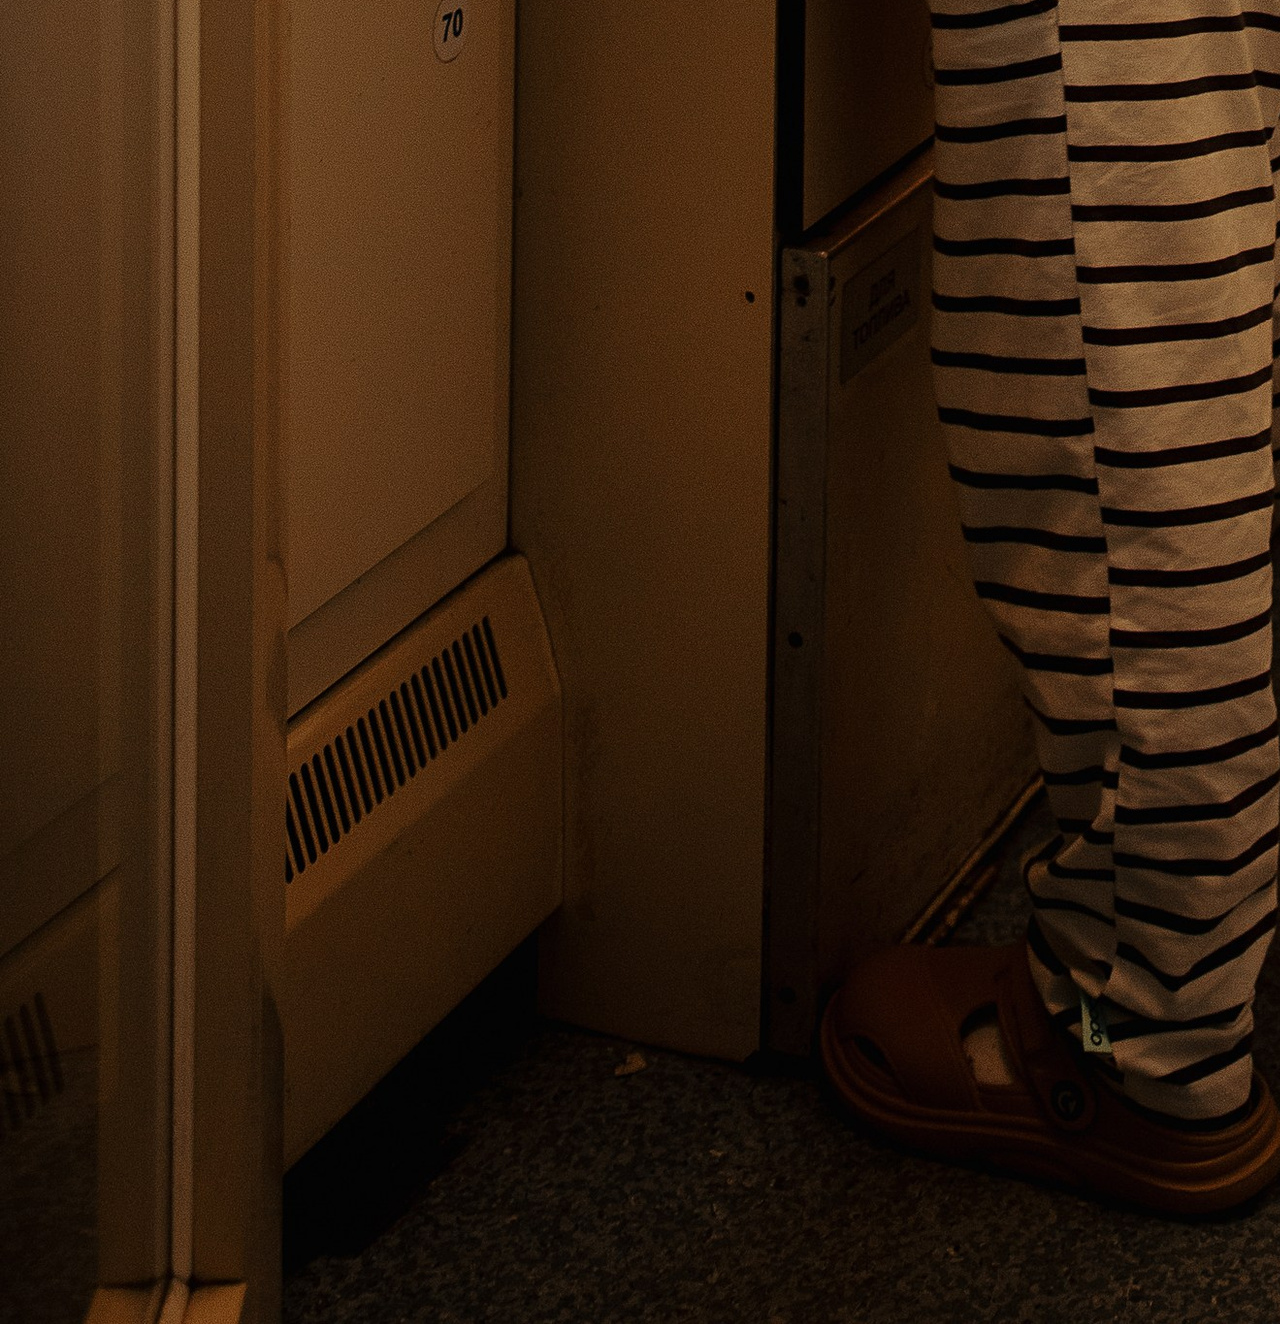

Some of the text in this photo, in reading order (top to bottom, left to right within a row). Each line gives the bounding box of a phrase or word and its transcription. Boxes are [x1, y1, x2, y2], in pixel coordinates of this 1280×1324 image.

[442, 7, 463, 43] 70
[868, 268, 895, 312] ДЛЯ
[852, 287, 911, 351] ТОПЛИВА
